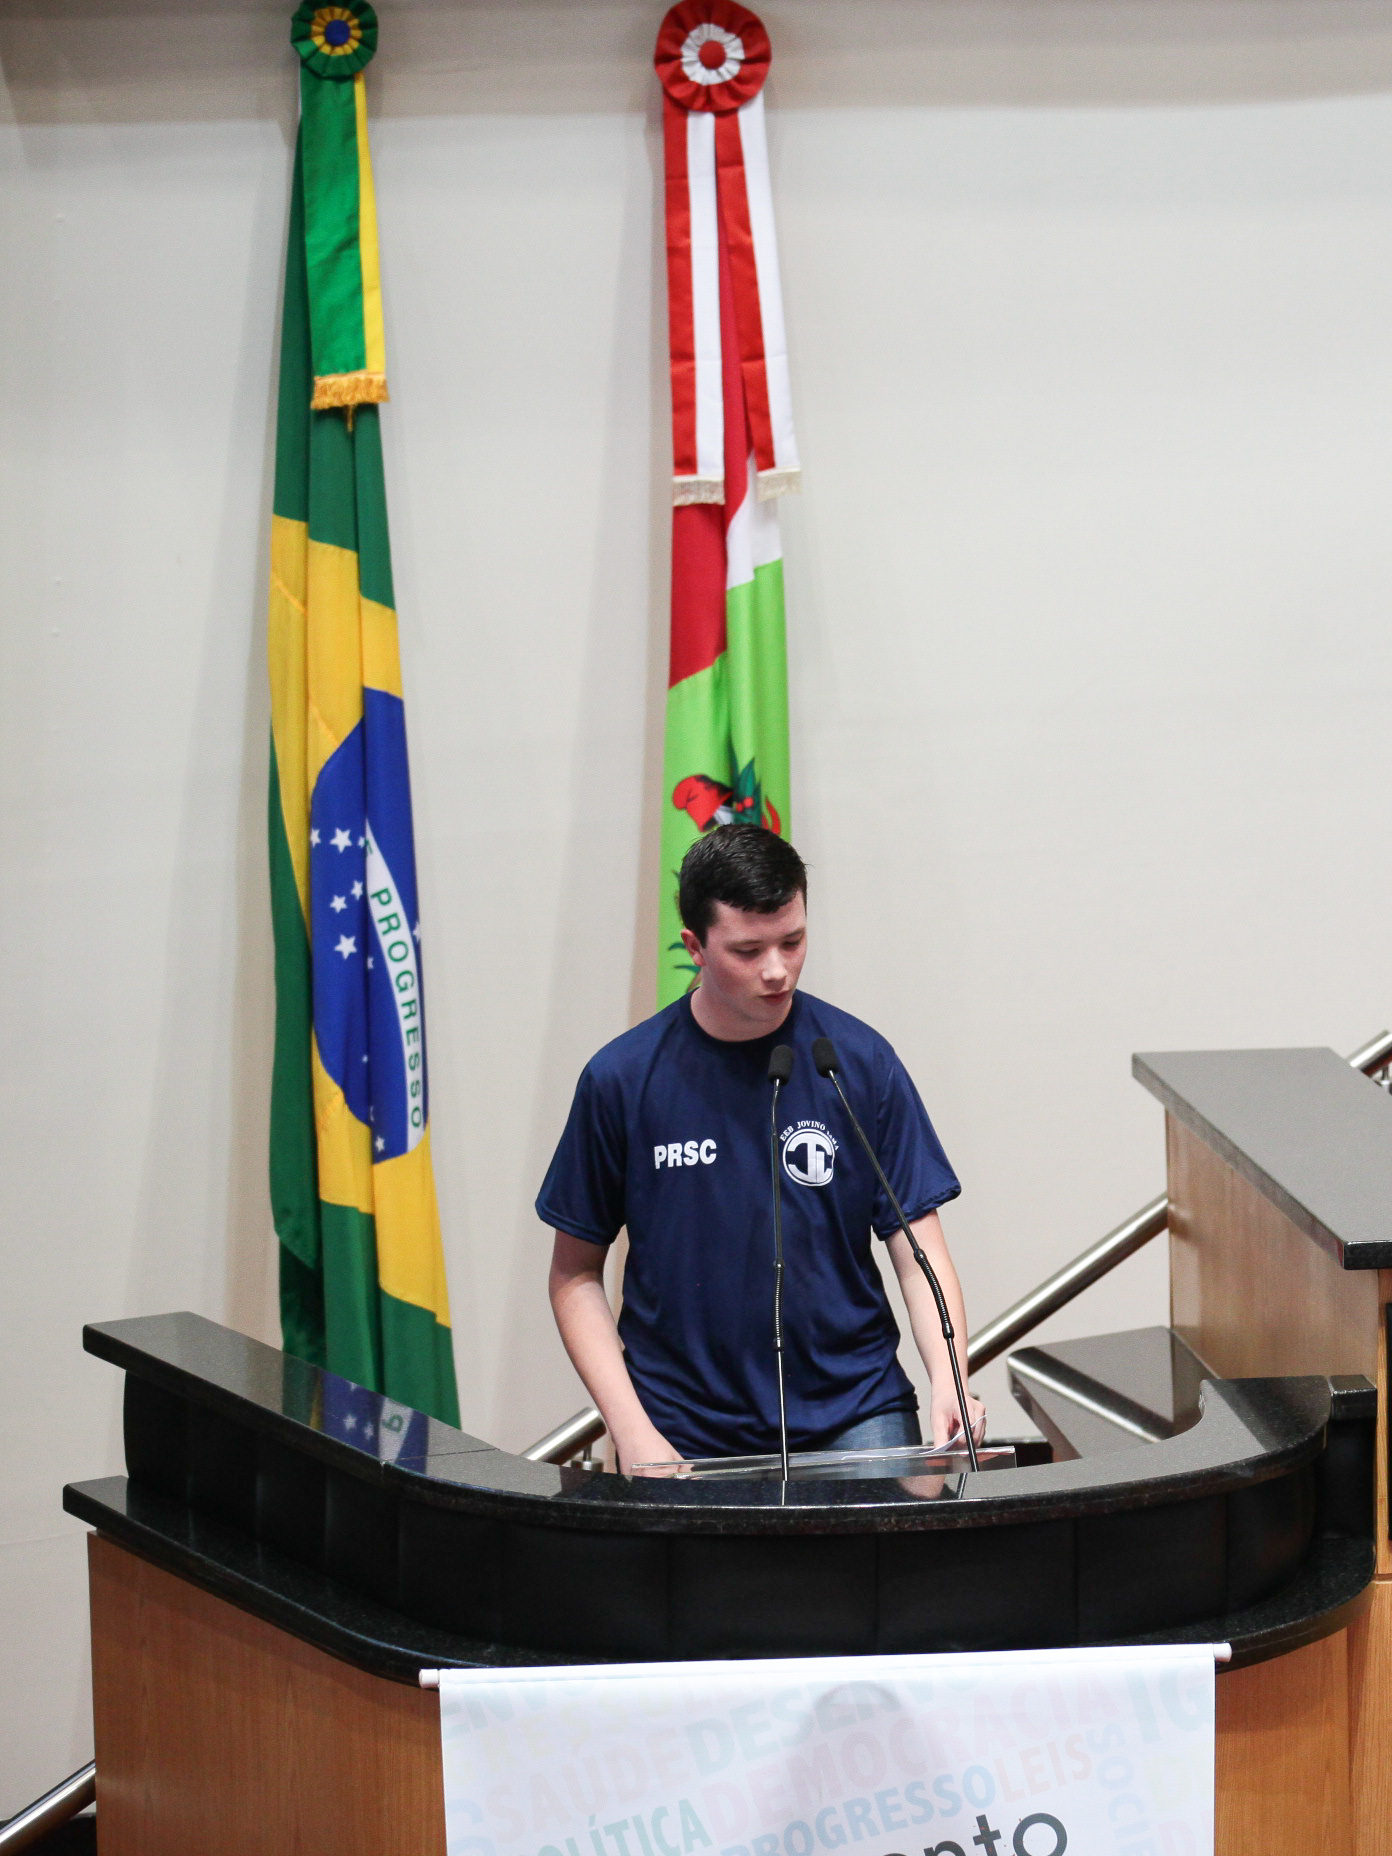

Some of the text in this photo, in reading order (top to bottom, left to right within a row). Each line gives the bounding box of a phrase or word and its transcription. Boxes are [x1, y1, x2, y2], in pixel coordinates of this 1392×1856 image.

[370, 886, 422, 1129] PROGRESSO
[654, 1139, 717, 1169] PRSC
[780, 1125, 794, 1141] EEB
[797, 1120, 826, 1130] JOVINO
[700, 1670, 1120, 1844] DEMOCRACIA
[994, 1733, 1093, 1803] LEIS
